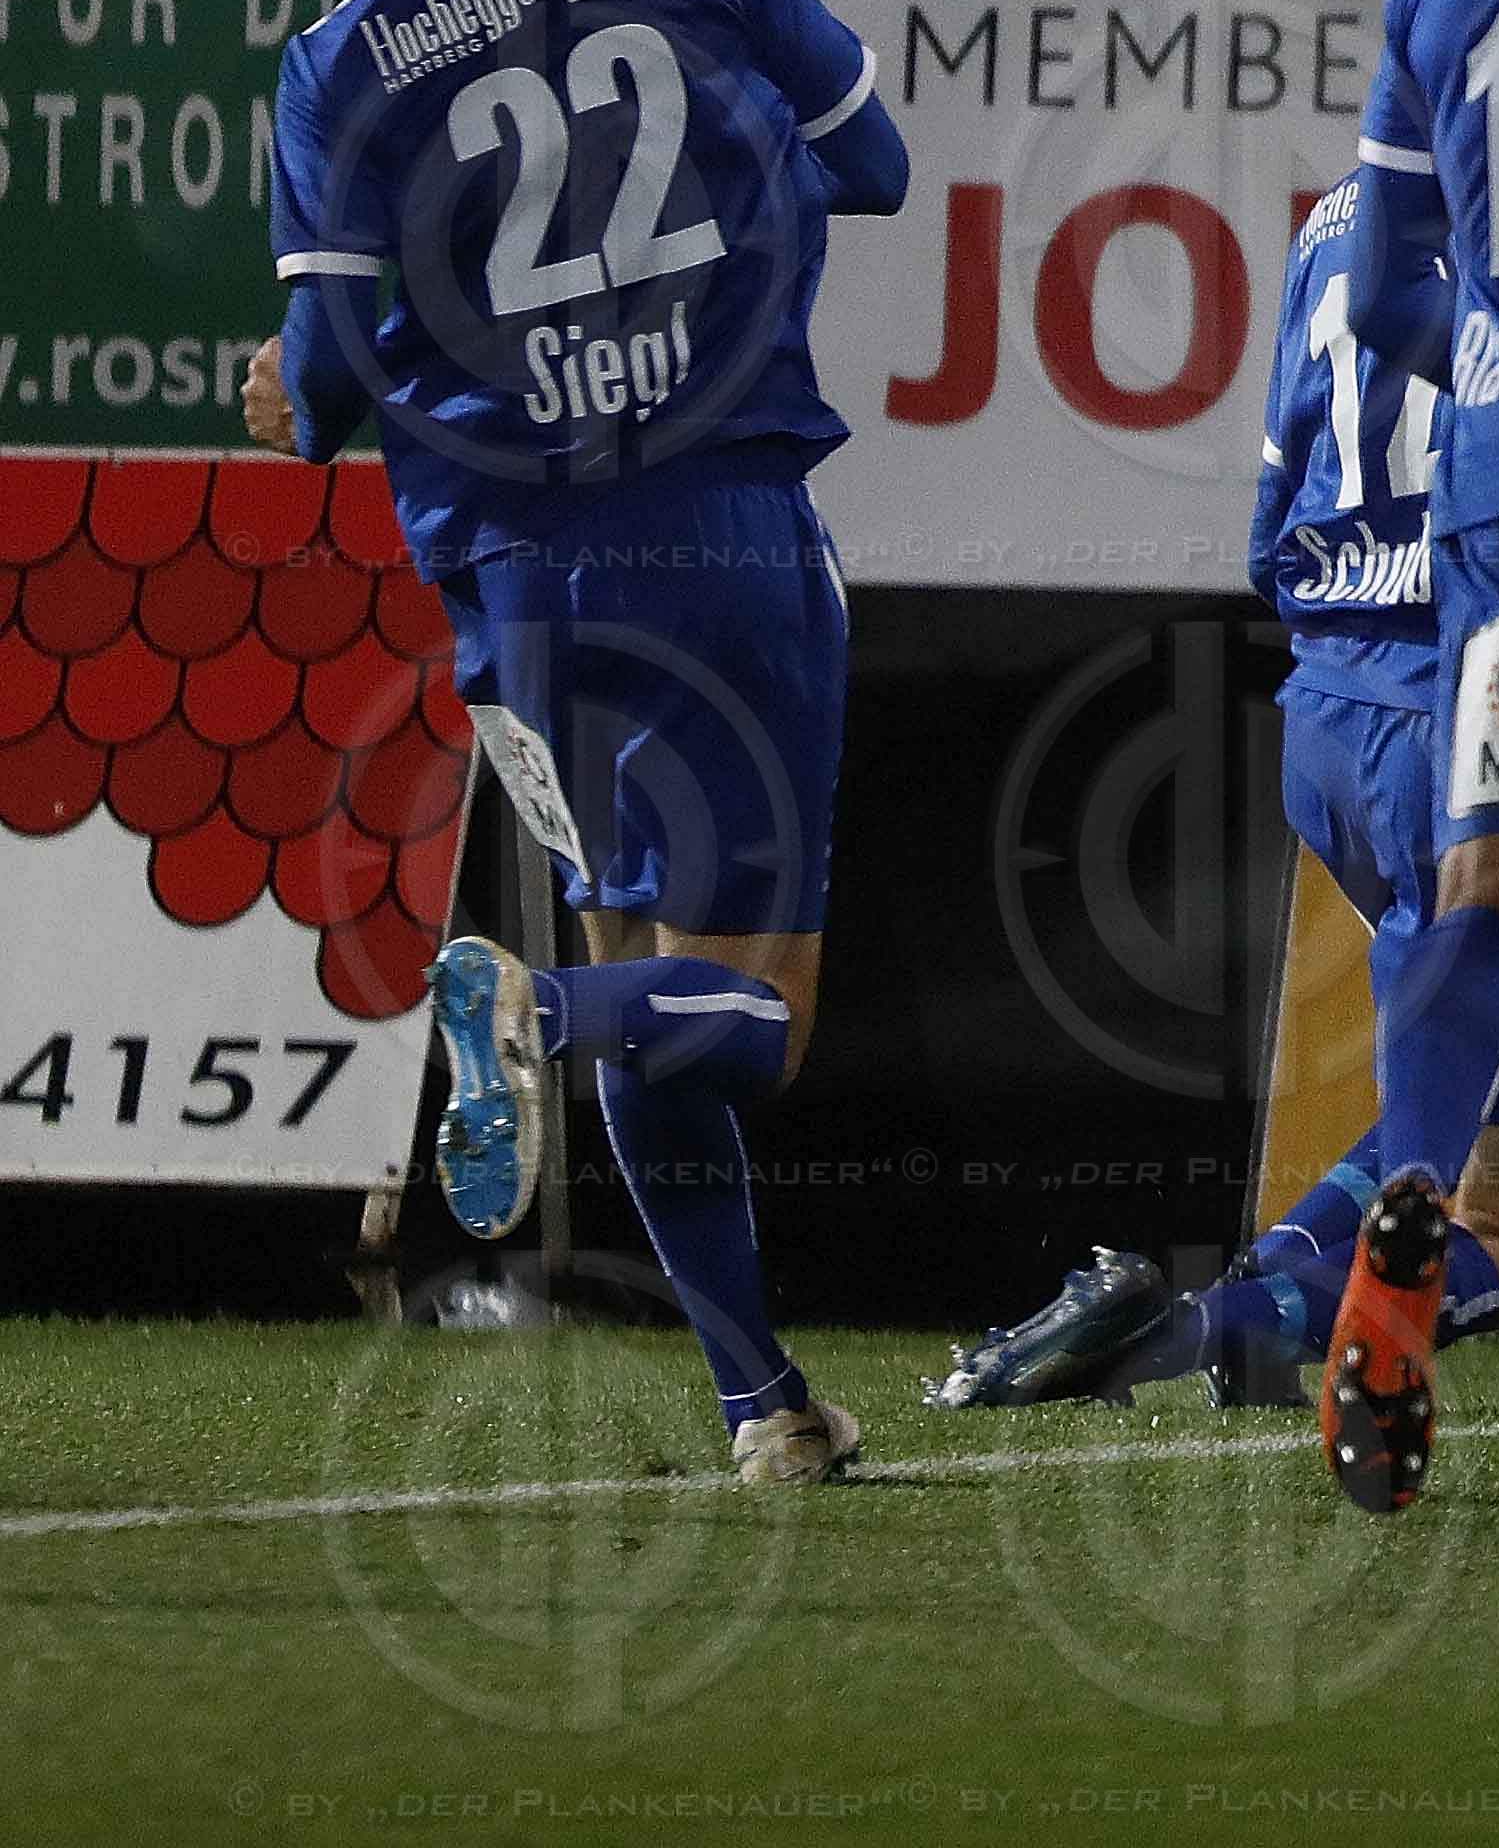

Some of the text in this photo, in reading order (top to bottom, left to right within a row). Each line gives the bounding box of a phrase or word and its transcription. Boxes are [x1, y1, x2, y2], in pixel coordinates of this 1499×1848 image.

[383, 37, 485, 95] HARTBERG
[903, 5, 1362, 116] MEMBE
[447, 24, 727, 316] 22
[522, 301, 691, 424] Siegl
[1, 1033, 358, 1130] 4157
